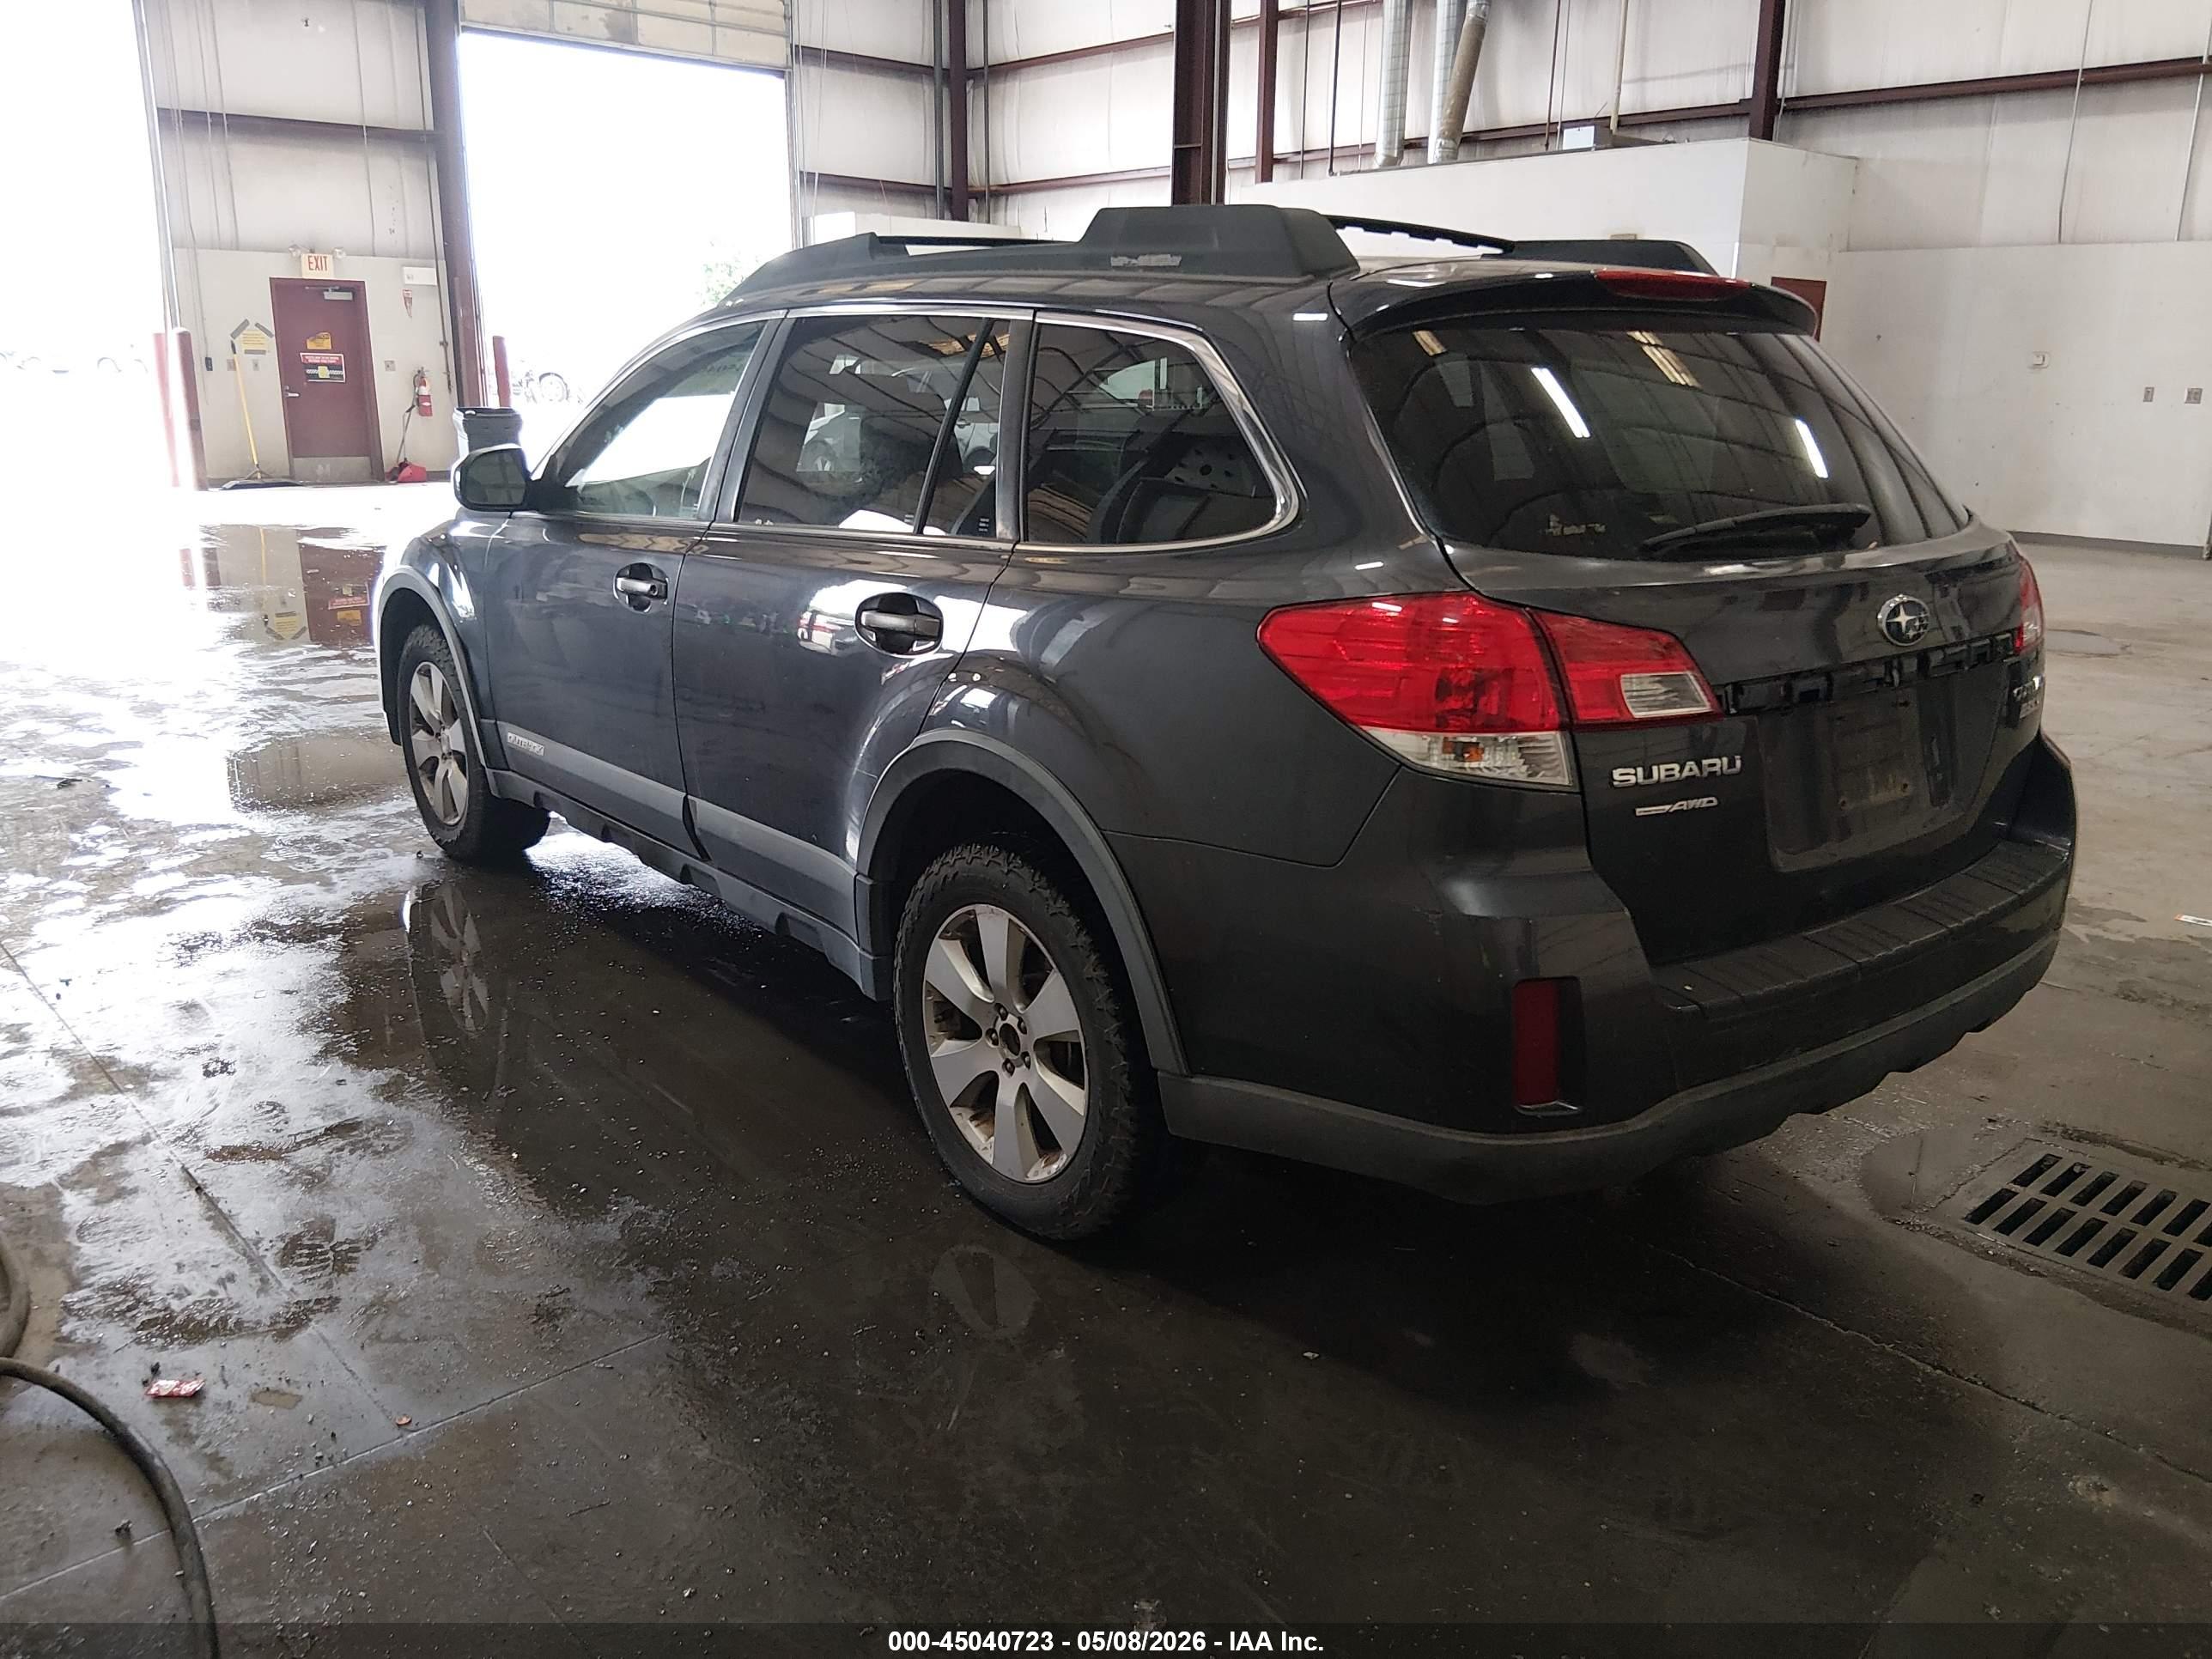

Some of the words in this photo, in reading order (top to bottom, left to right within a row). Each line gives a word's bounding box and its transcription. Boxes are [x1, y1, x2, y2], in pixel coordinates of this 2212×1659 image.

[307, 255, 328, 271] EXIT
[1612, 755, 1742, 788] SUBARU
[1669, 796, 1718, 813] AWD
